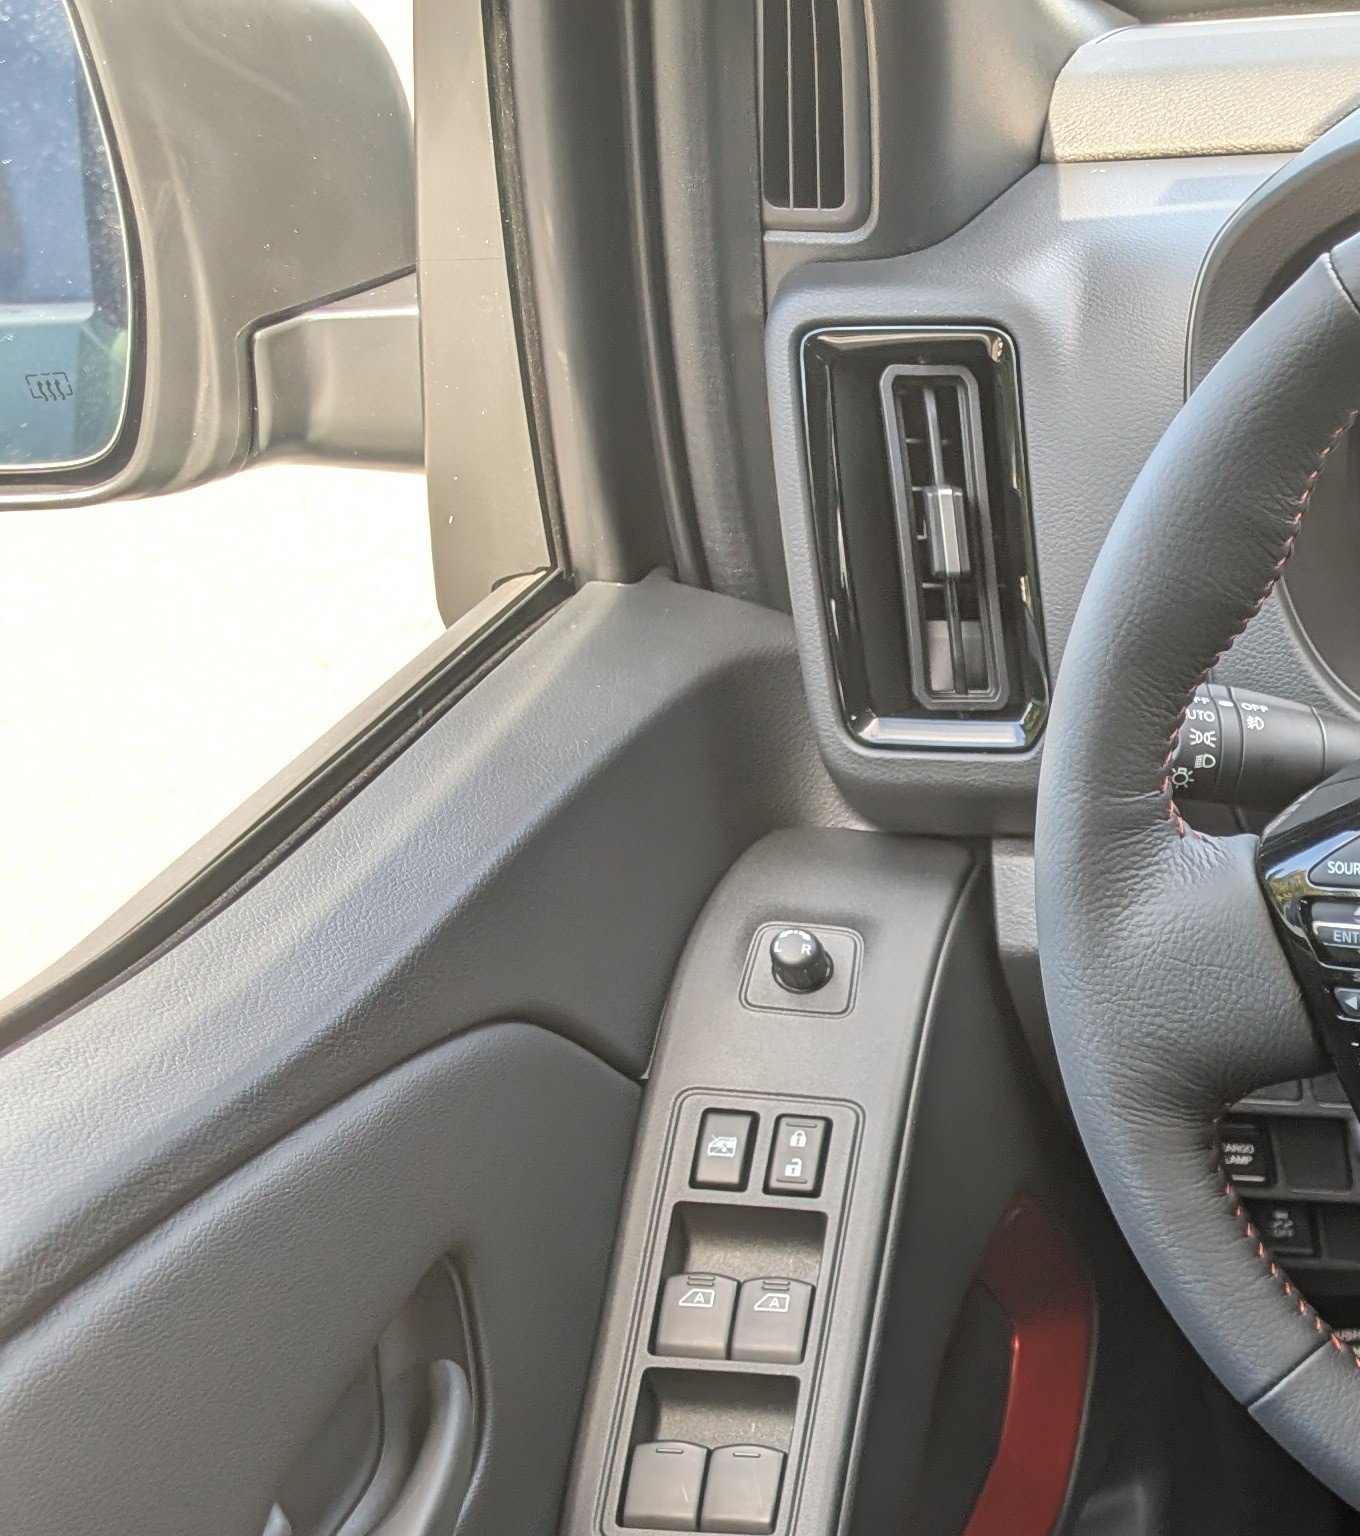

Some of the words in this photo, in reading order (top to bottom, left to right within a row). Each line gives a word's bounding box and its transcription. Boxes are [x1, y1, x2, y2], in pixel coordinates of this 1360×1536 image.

[1241, 702, 1269, 713] OFF
[1186, 708, 1216, 723] UTO
[773, 941, 782, 953] L
[801, 943, 812, 955] R
